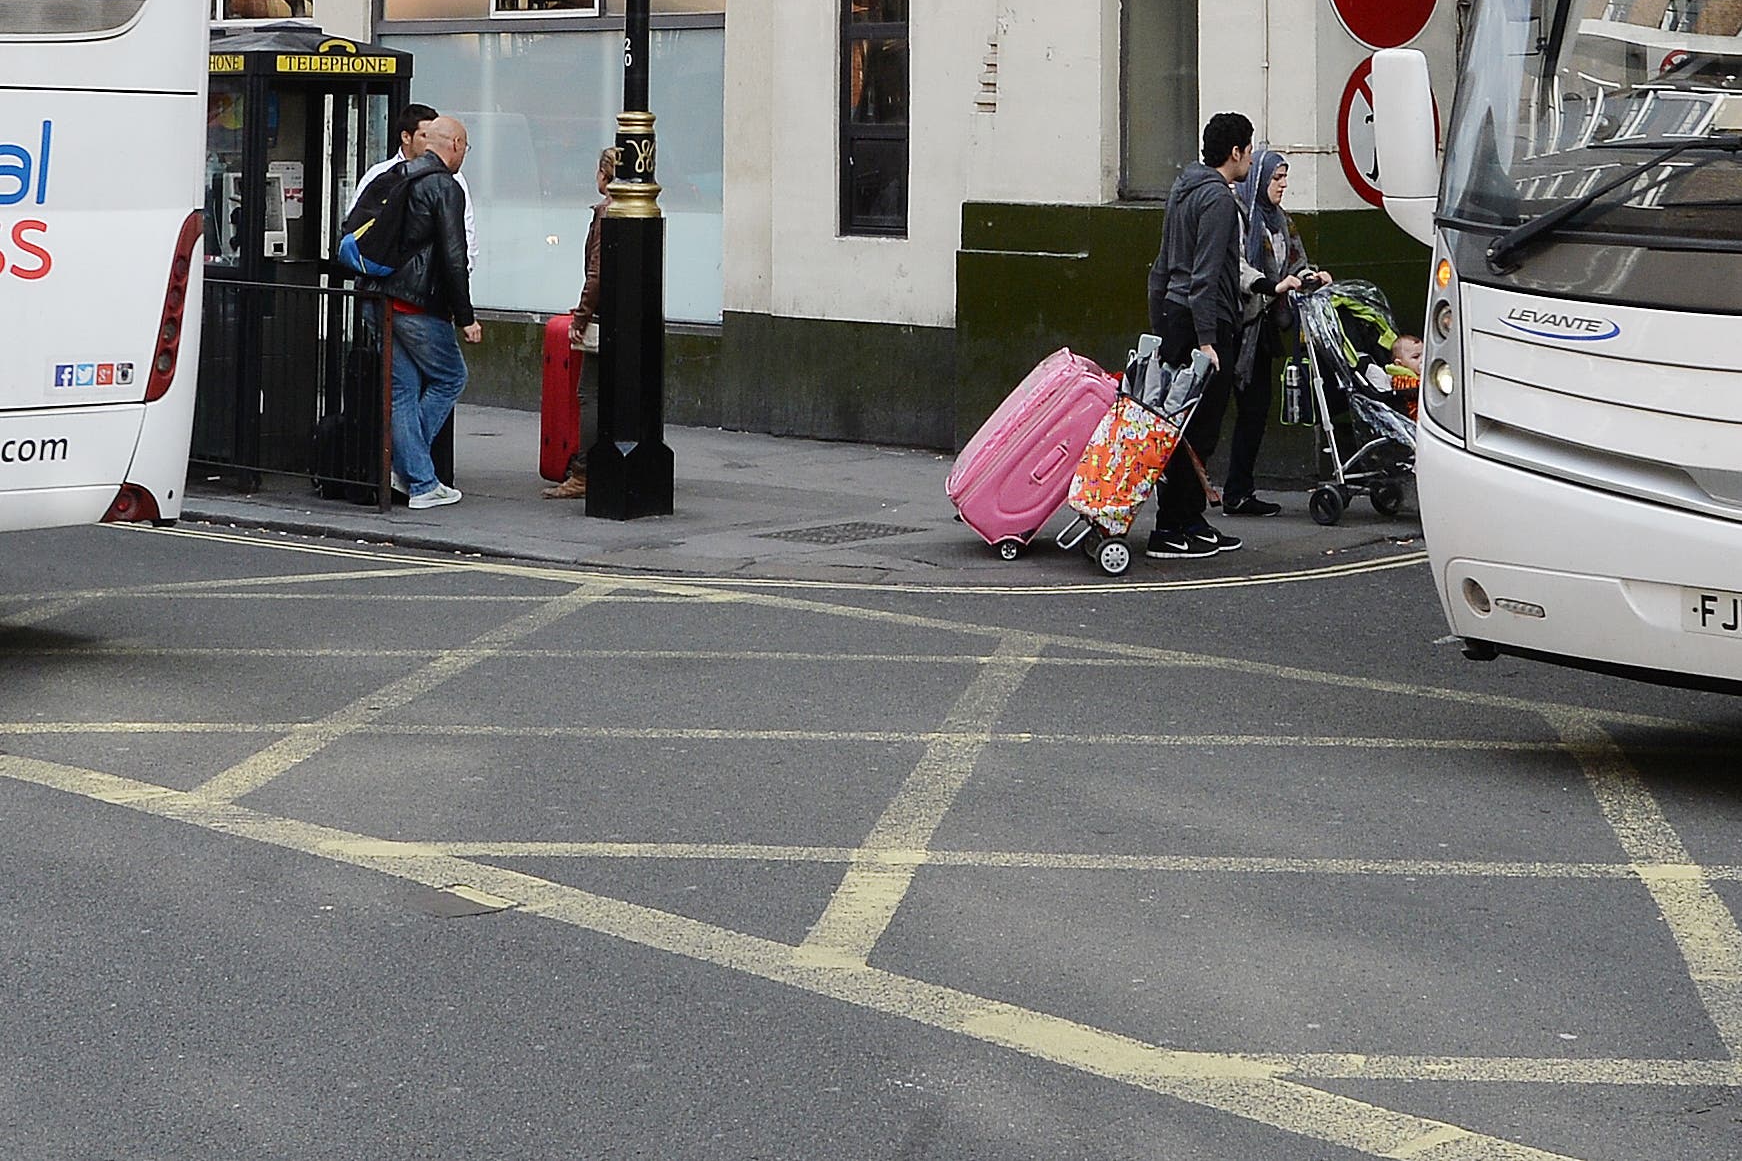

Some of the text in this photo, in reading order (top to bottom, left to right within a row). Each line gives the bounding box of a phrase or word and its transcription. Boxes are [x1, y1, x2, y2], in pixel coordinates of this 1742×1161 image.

[284, 55, 389, 72] TELEPHONE
[0, 219, 52, 280] s
[1507, 308, 1602, 332] LEVANTE
